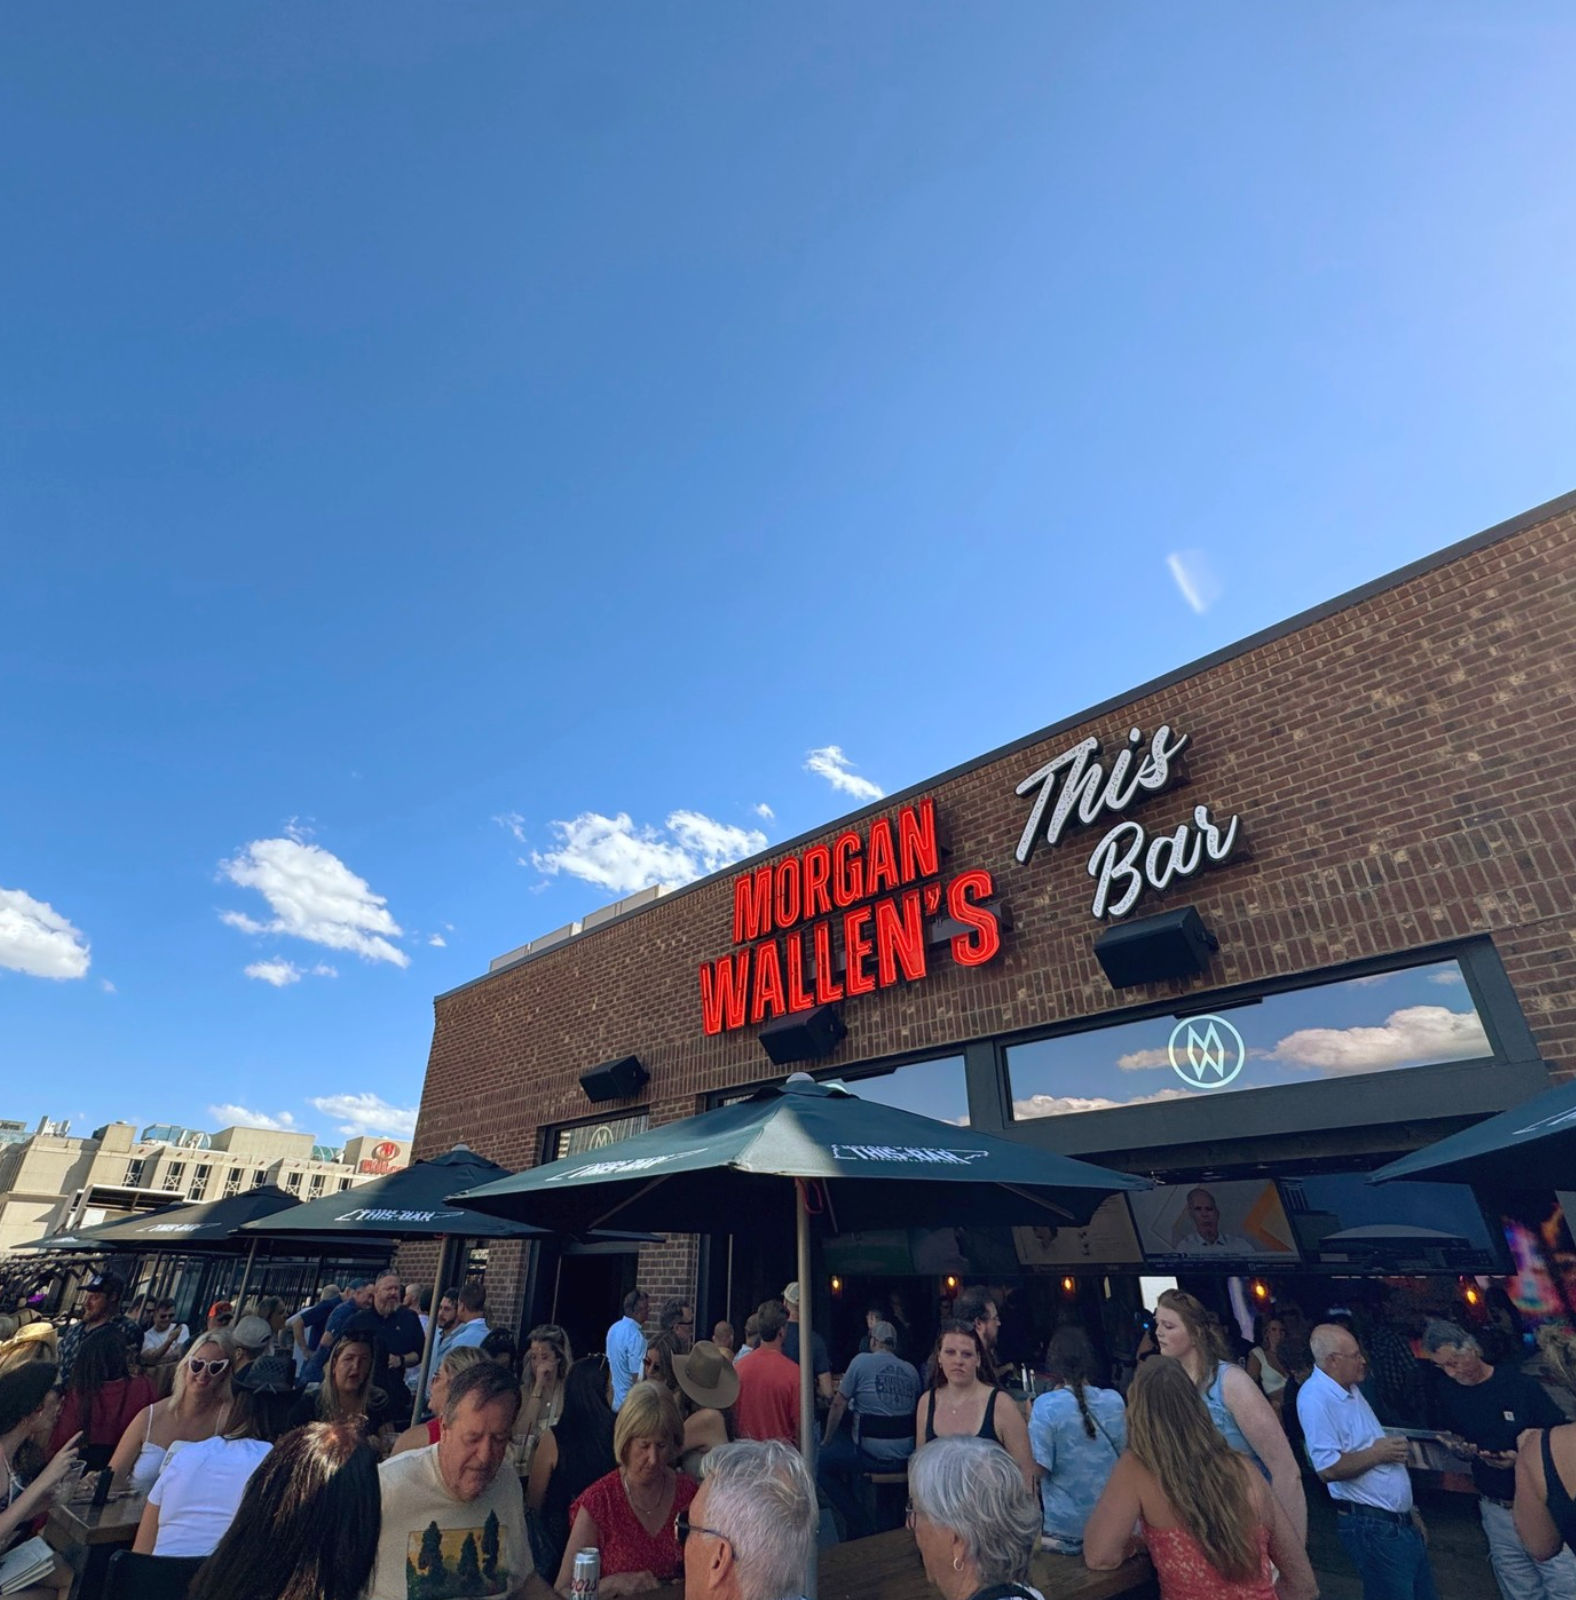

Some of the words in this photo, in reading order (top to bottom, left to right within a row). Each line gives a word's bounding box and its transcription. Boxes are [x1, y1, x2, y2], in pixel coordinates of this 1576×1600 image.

[1015, 725, 1188, 863] This
[1087, 804, 1239, 919] Bar
[732, 797, 939, 945] MORGAN
[700, 869, 1000, 1036] WALLEN'S
